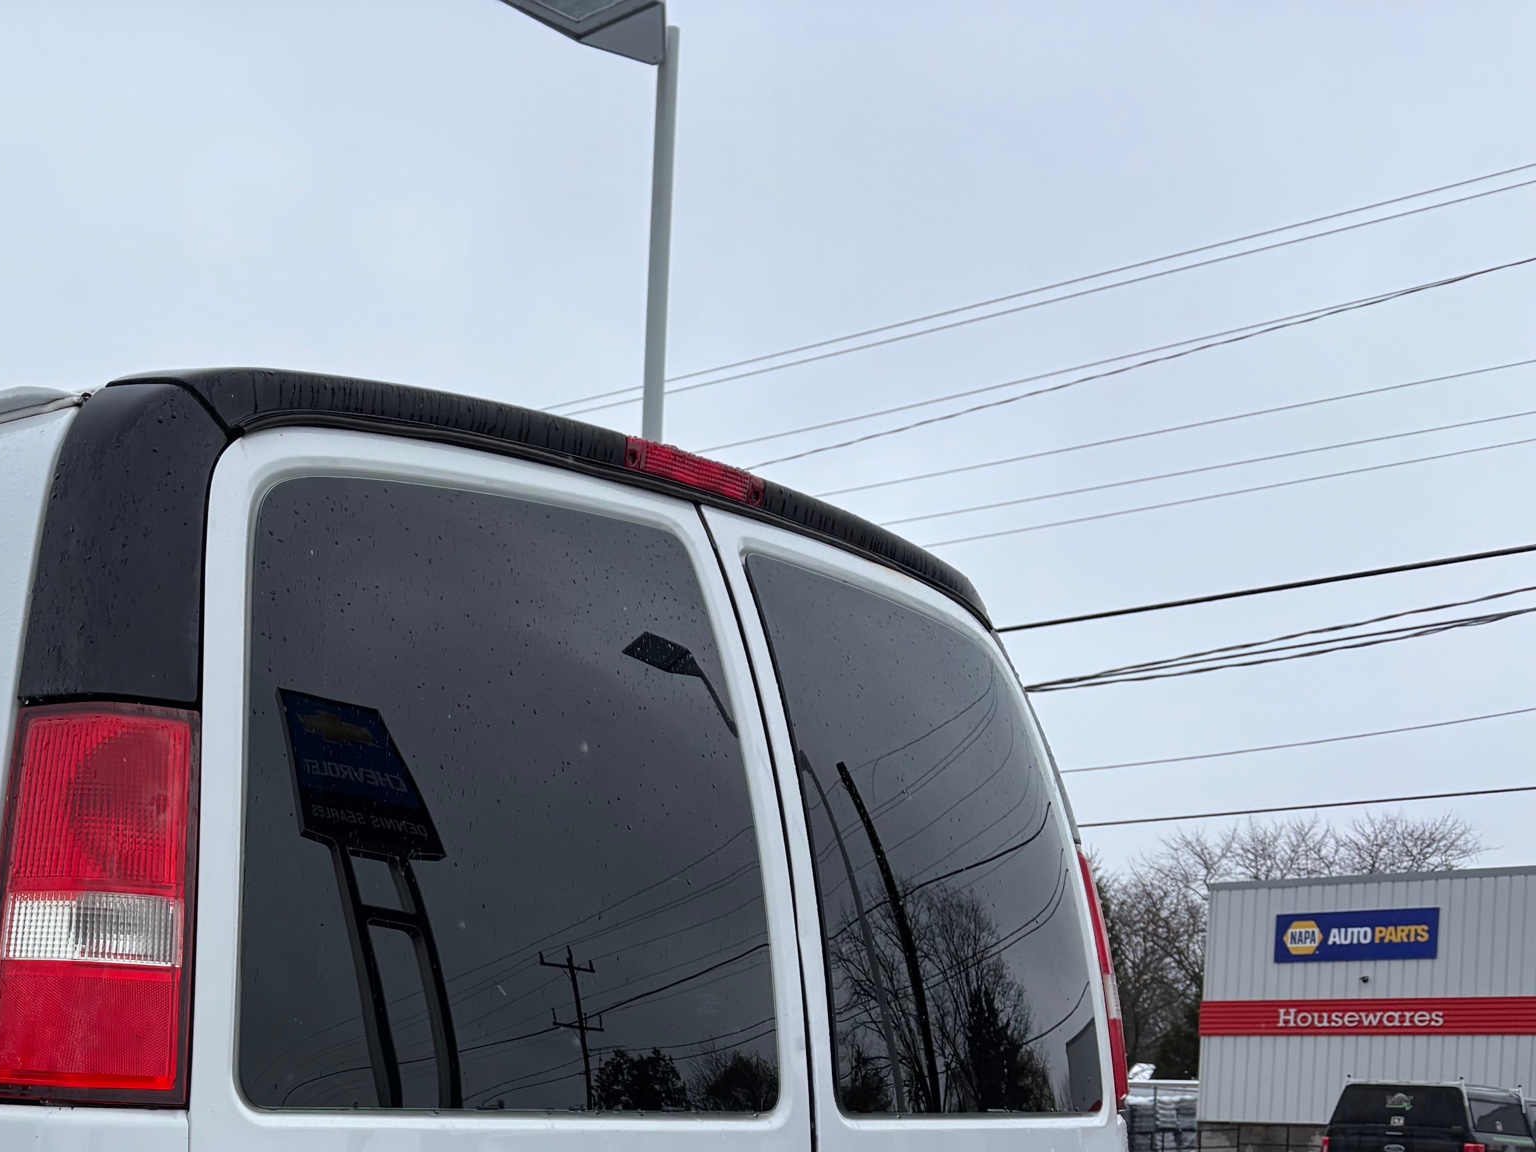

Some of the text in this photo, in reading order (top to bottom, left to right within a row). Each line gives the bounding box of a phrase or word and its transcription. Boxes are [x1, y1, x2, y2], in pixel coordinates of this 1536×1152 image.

[1289, 925, 1429, 945] NAPA AUTO PARTS
[1277, 1008, 1444, 1027] Housewares
